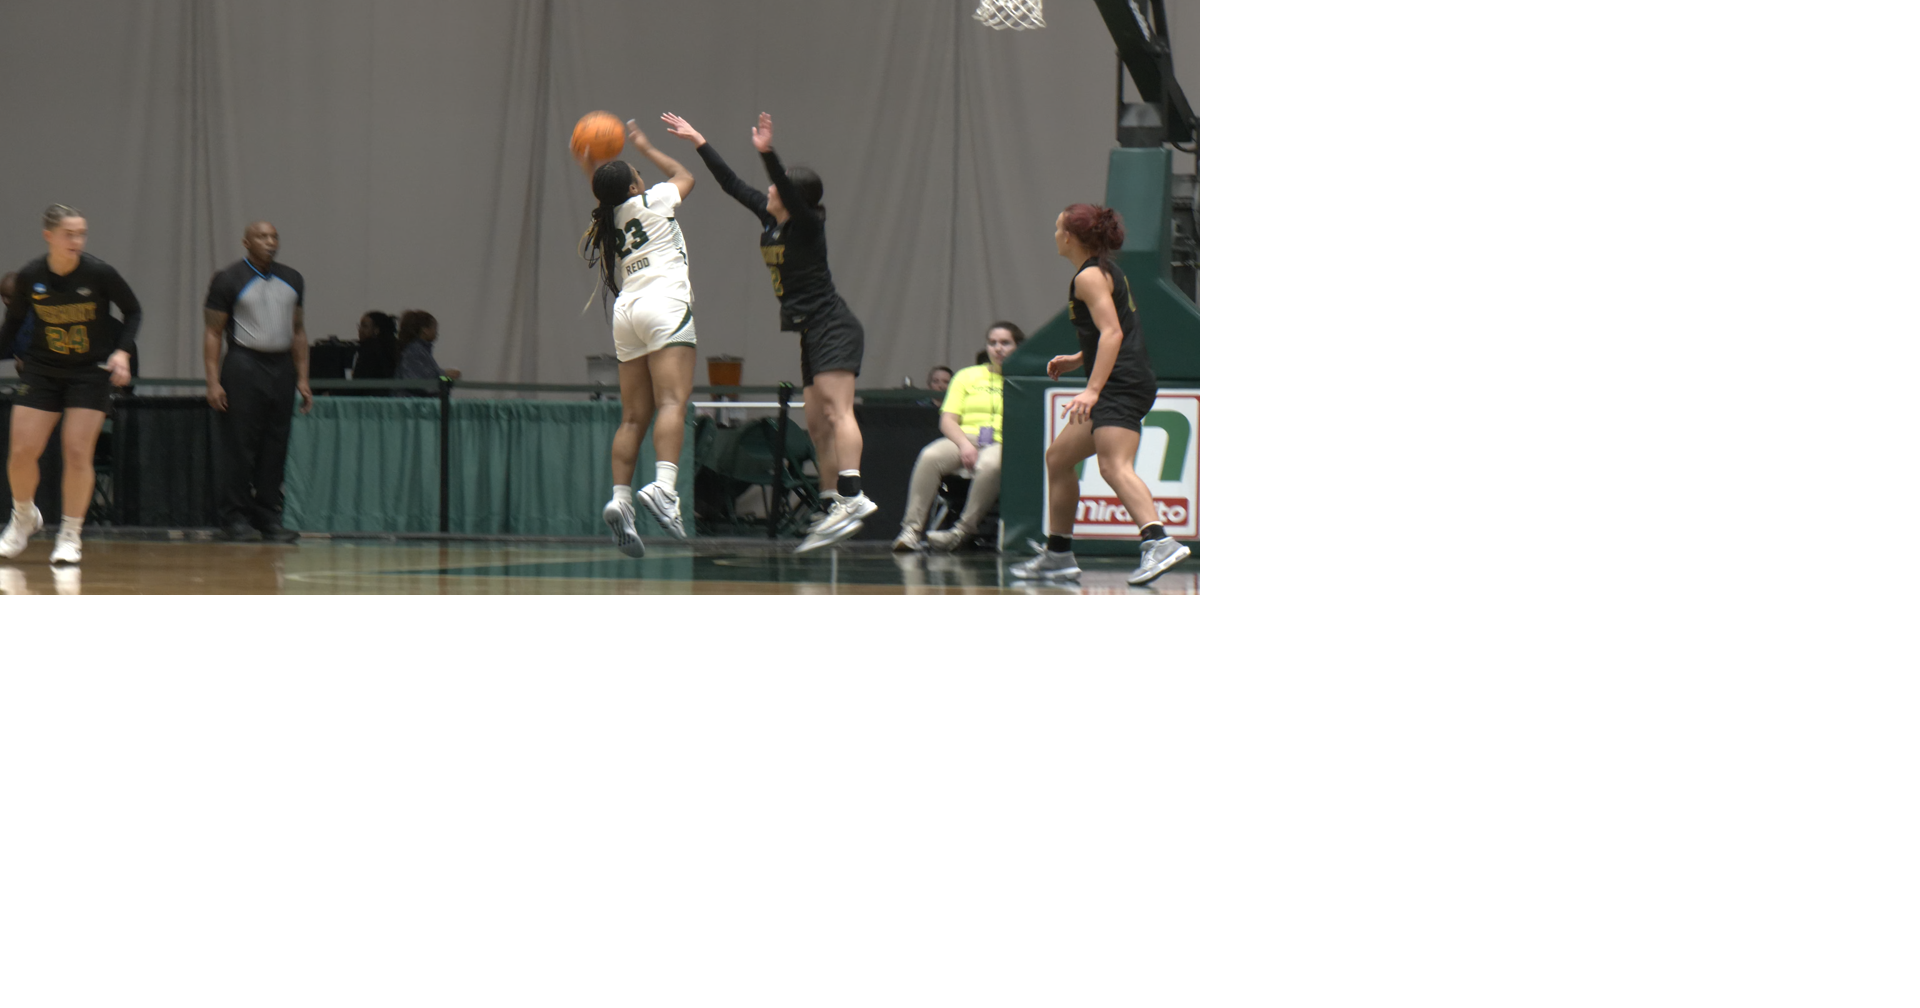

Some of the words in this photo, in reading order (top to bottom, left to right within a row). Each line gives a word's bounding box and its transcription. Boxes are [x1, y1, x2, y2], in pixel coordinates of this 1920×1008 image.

[615, 218, 650, 260] 23
[626, 257, 650, 276] REDD
[45, 325, 90, 355] 24
[1075, 499, 1187, 523] Mirato
